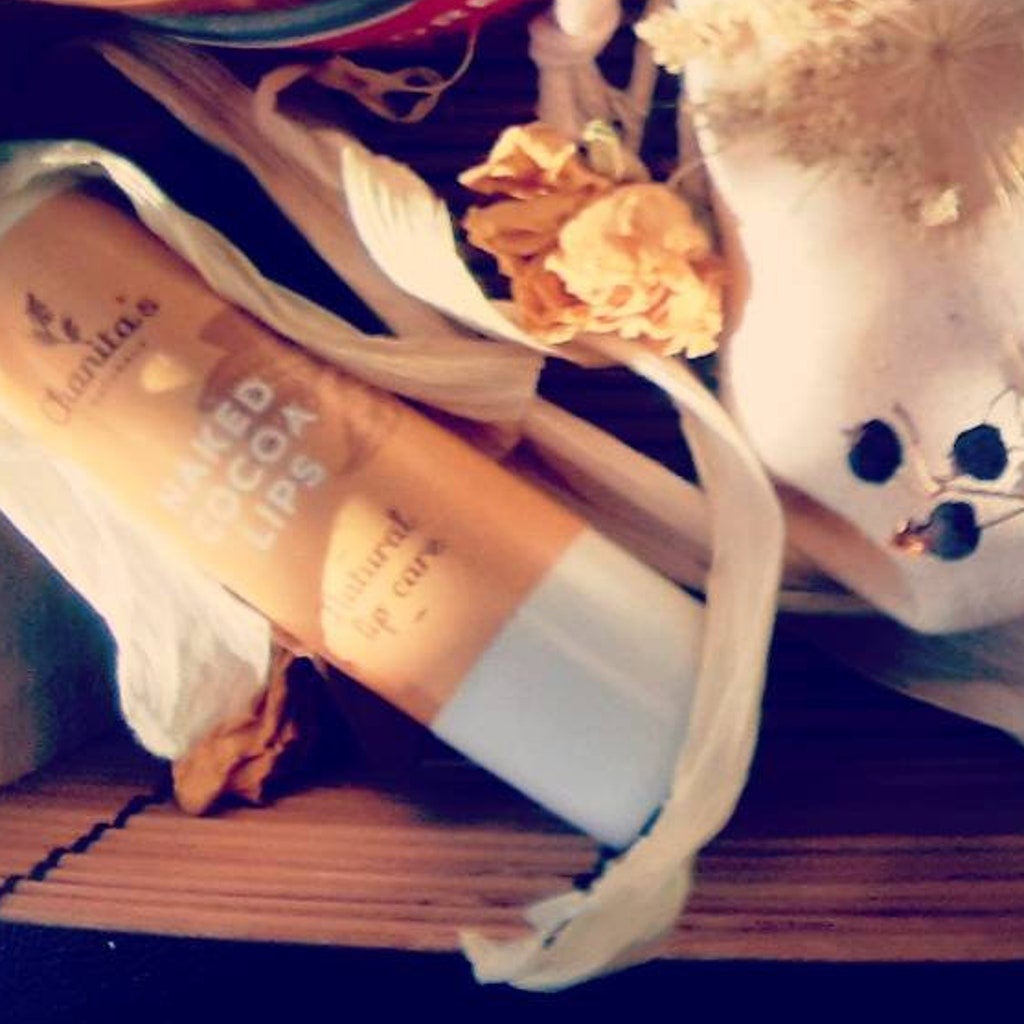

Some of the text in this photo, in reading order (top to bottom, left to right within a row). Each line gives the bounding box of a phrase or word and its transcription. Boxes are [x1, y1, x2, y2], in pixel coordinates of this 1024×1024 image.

[157, 378, 275, 515] NAKED
[189, 404, 319, 544] COCOA
[245, 454, 326, 551] LIPS
